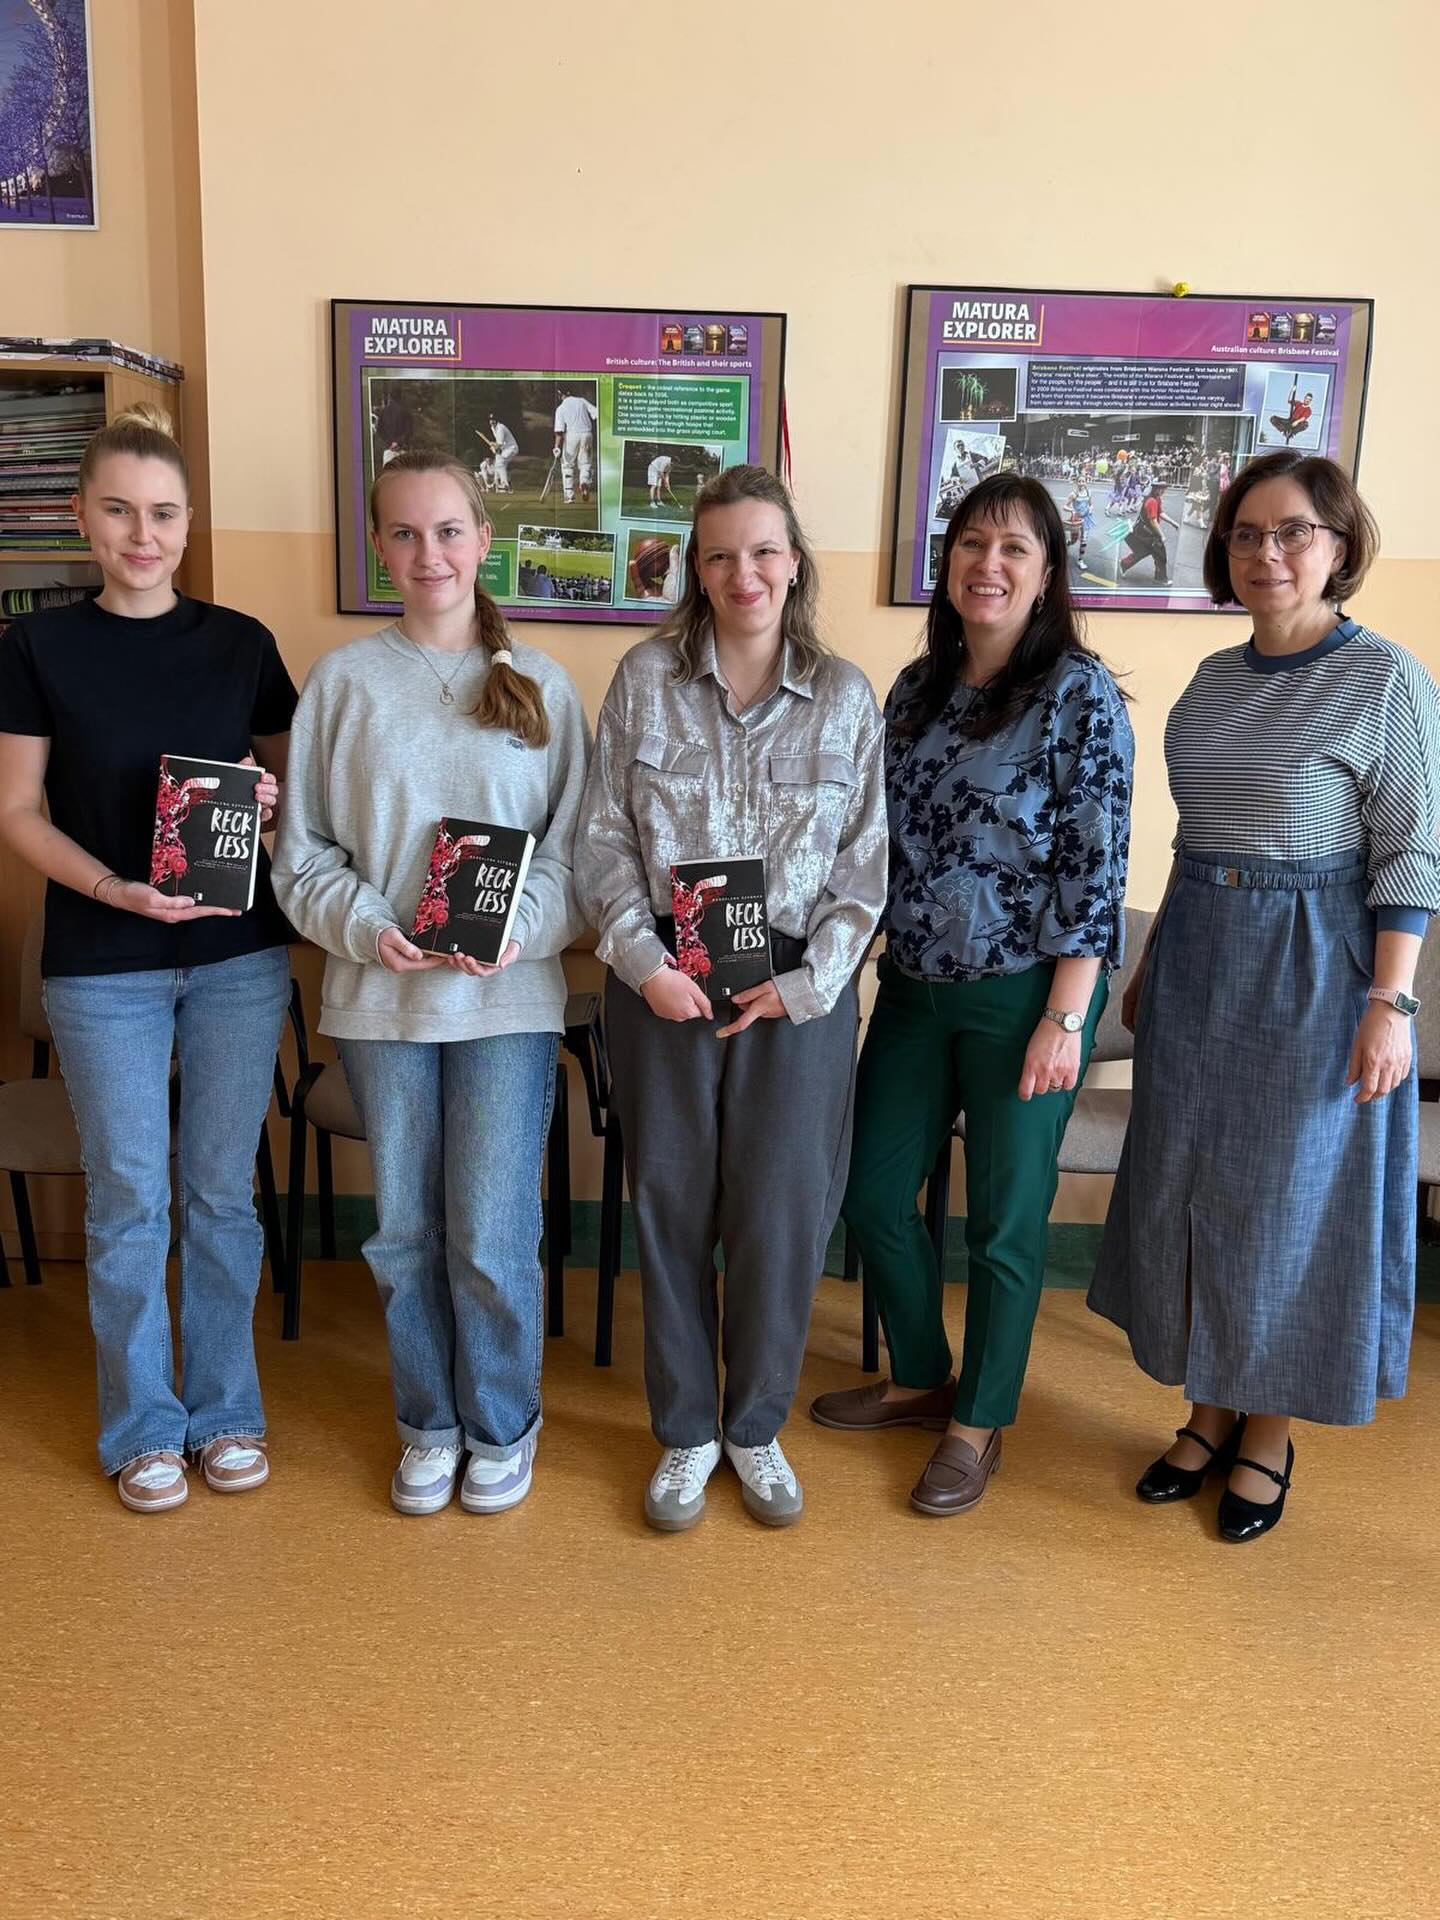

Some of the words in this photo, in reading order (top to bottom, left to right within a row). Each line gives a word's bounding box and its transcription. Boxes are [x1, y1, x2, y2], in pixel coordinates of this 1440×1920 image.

[952, 302, 1029, 320] MATURA
[372, 318, 448, 335] MATURA
[943, 321, 1036, 340] EXPLORER
[364, 337, 455, 354] EXPLORER
[1211, 345, 1248, 353] Australian
[1249, 346, 1277, 354] culture:
[1278, 346, 1309, 355] Brisbane
[1311, 347, 1339, 356] Festival
[630, 358, 657, 366] culture:
[672, 358, 695, 366] British
[696, 359, 710, 367] and
[711, 359, 728, 367] their
[729, 360, 752, 369] sports
[211, 807, 253, 836] RECK
[214, 834, 250, 859] LESS
[475, 863, 515, 891] RECK
[474, 890, 509, 914] LESS
[726, 902, 764, 928] RECK
[733, 926, 766, 952] LESS
